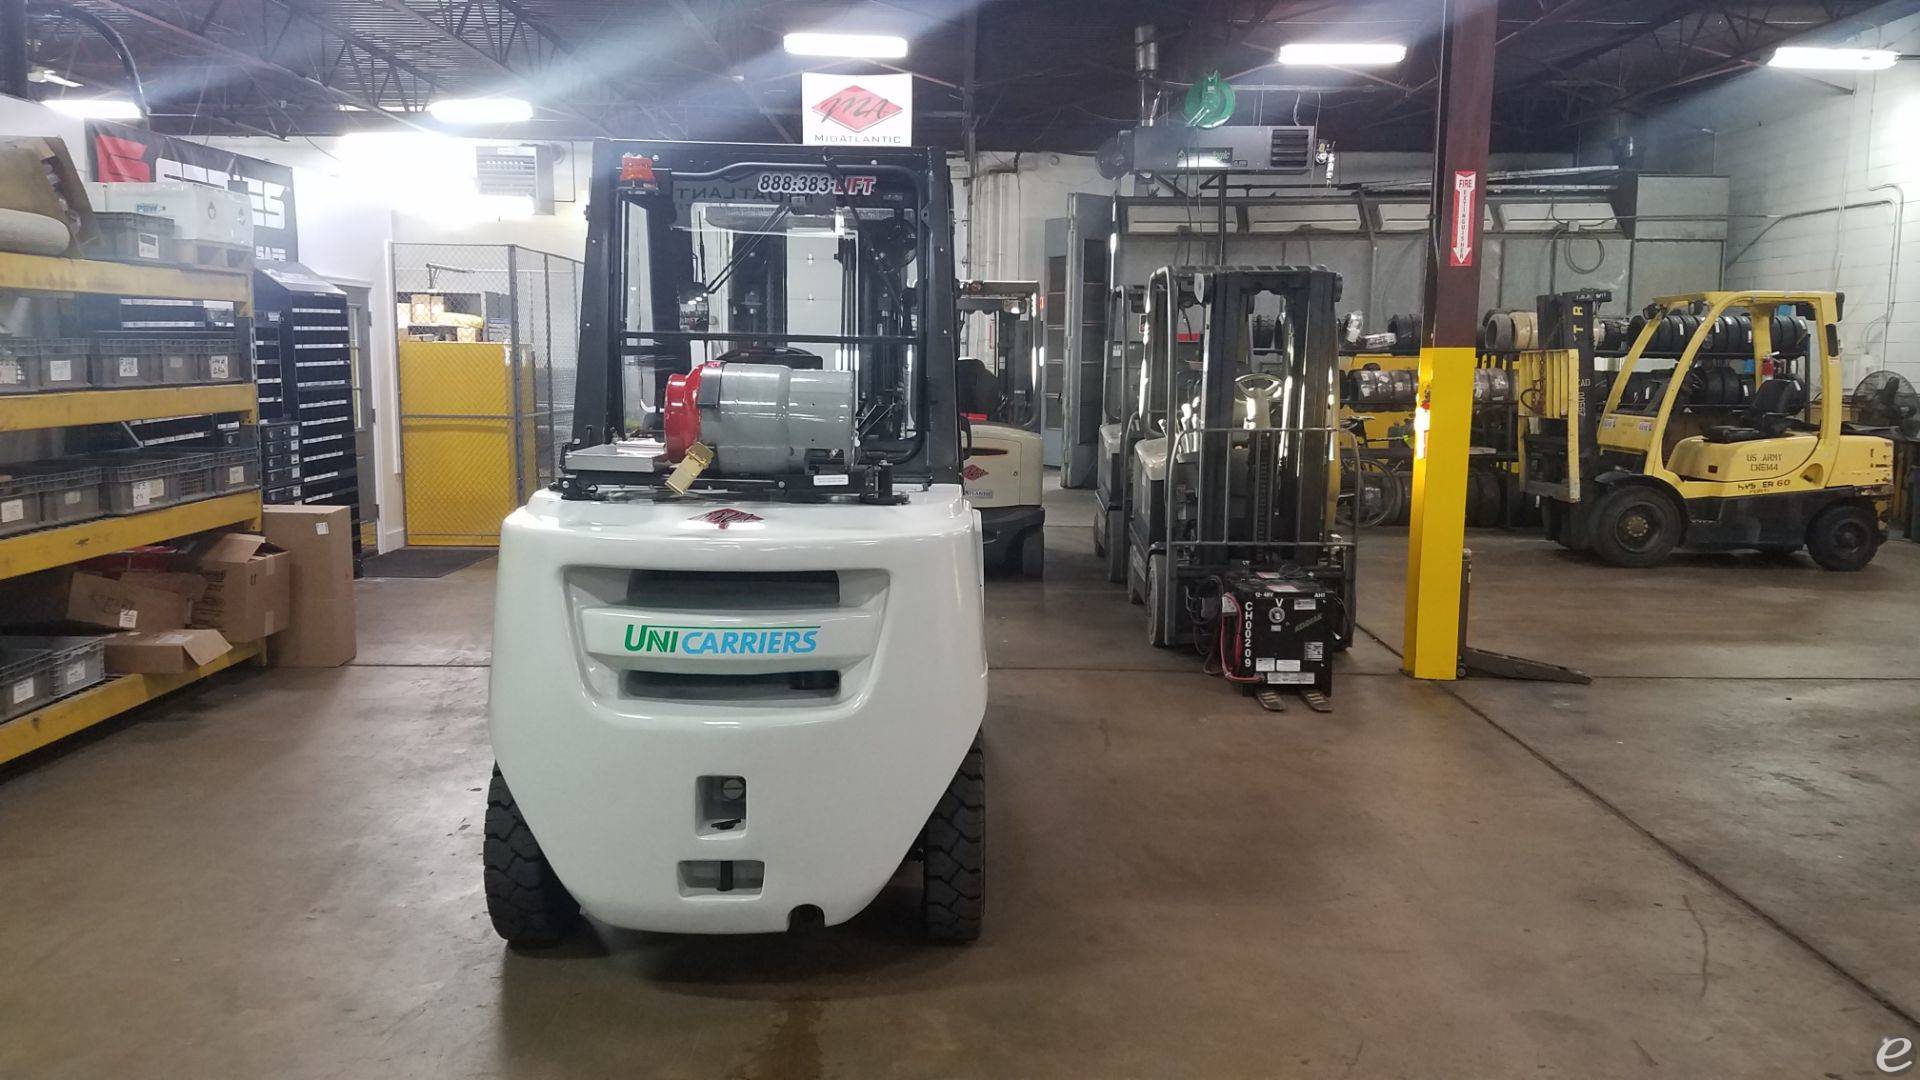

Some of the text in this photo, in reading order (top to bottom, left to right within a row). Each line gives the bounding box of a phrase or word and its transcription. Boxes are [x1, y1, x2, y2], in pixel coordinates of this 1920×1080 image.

[1459, 180, 1472, 188] FIRE
[1762, 453, 1783, 462] ARMY
[624, 624, 820, 655] UNICARRIERS
